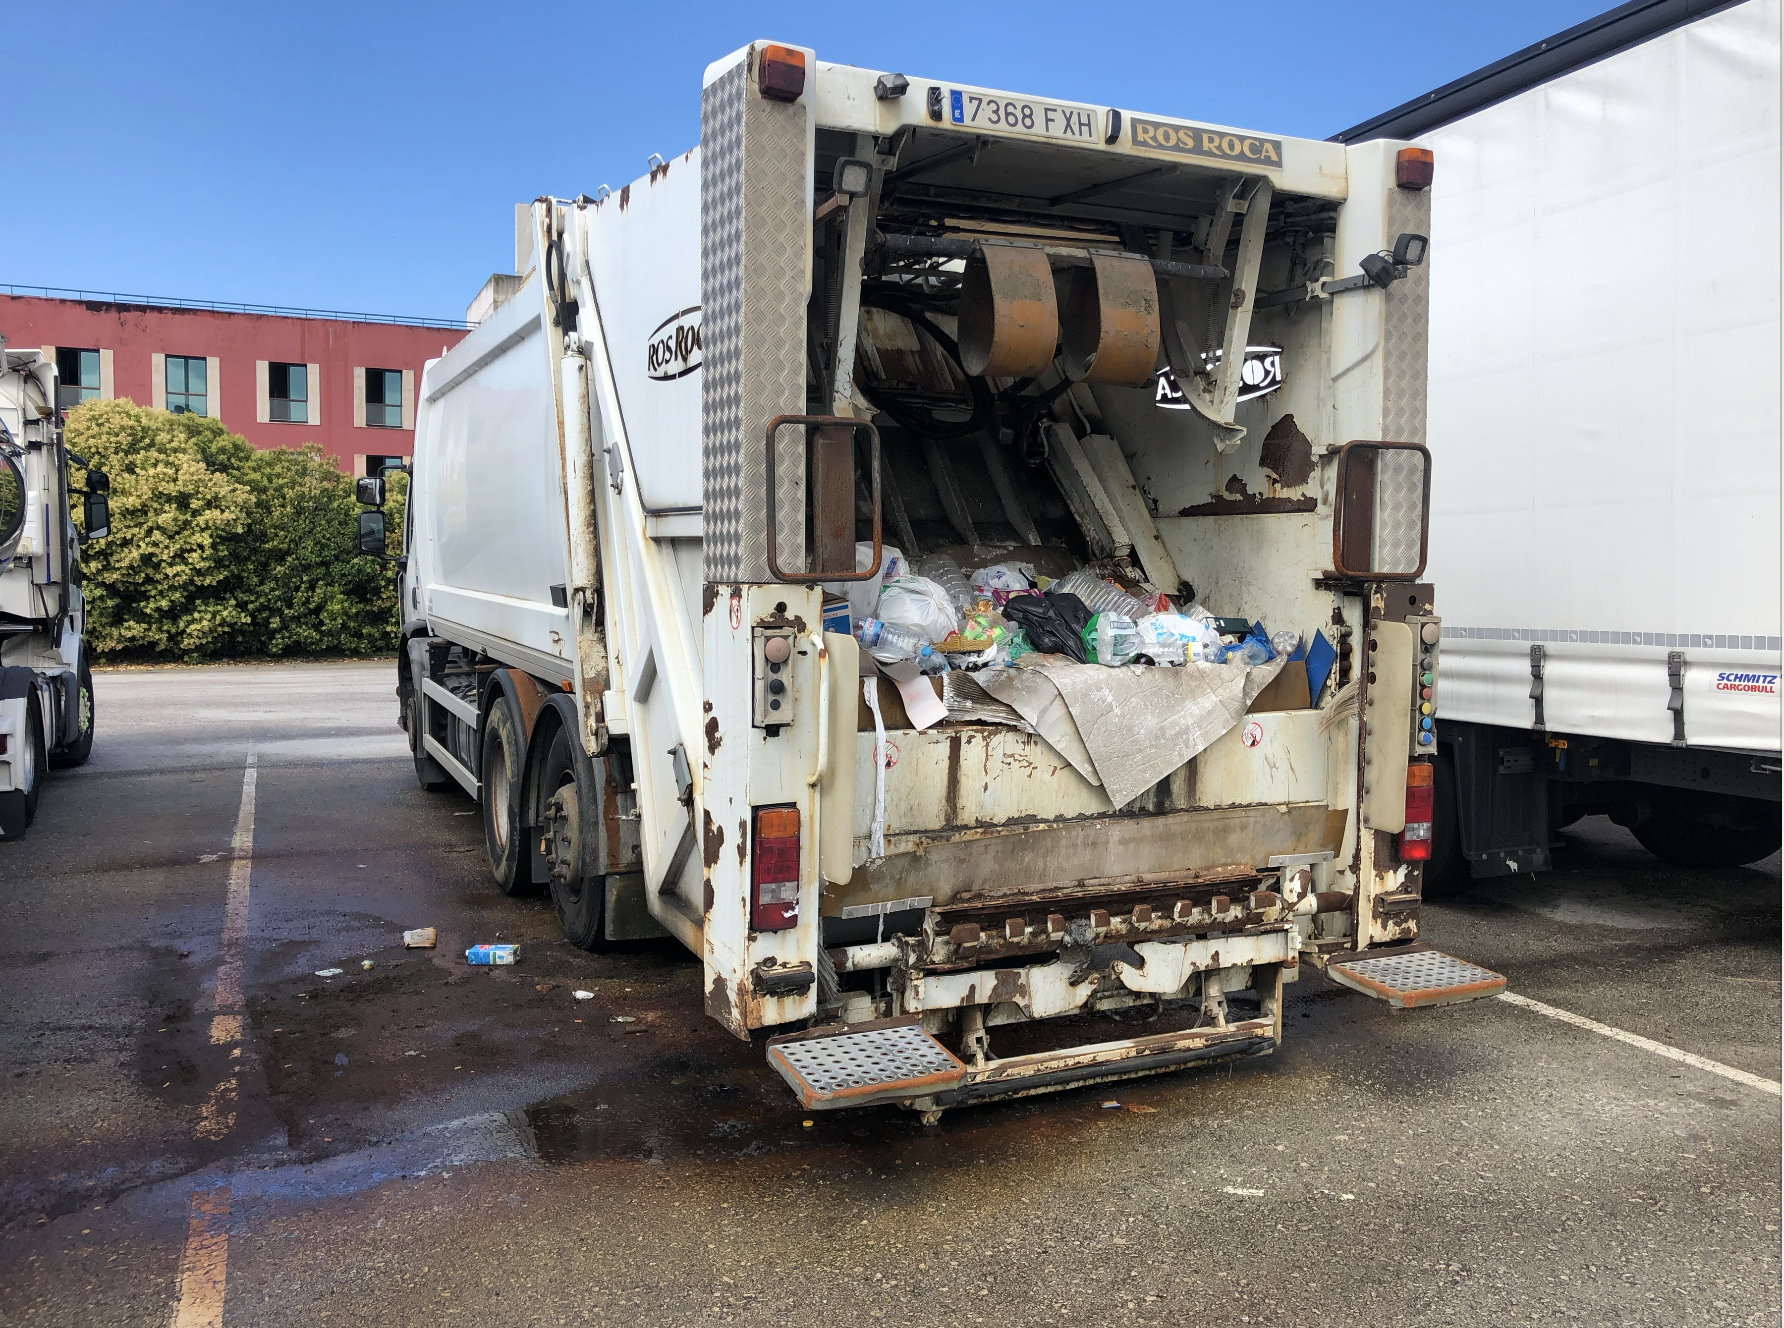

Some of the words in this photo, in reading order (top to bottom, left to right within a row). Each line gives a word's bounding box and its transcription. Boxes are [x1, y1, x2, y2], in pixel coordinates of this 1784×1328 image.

[968, 96, 1035, 130] 7368
[1043, 107, 1093, 138] FXH
[1136, 123, 1195, 149] ROS
[1201, 132, 1280, 162] ROCA
[648, 335, 673, 373] ROS
[1716, 672, 1778, 684] SCHMITZ
[1716, 683, 1775, 693] CARGOBULL
